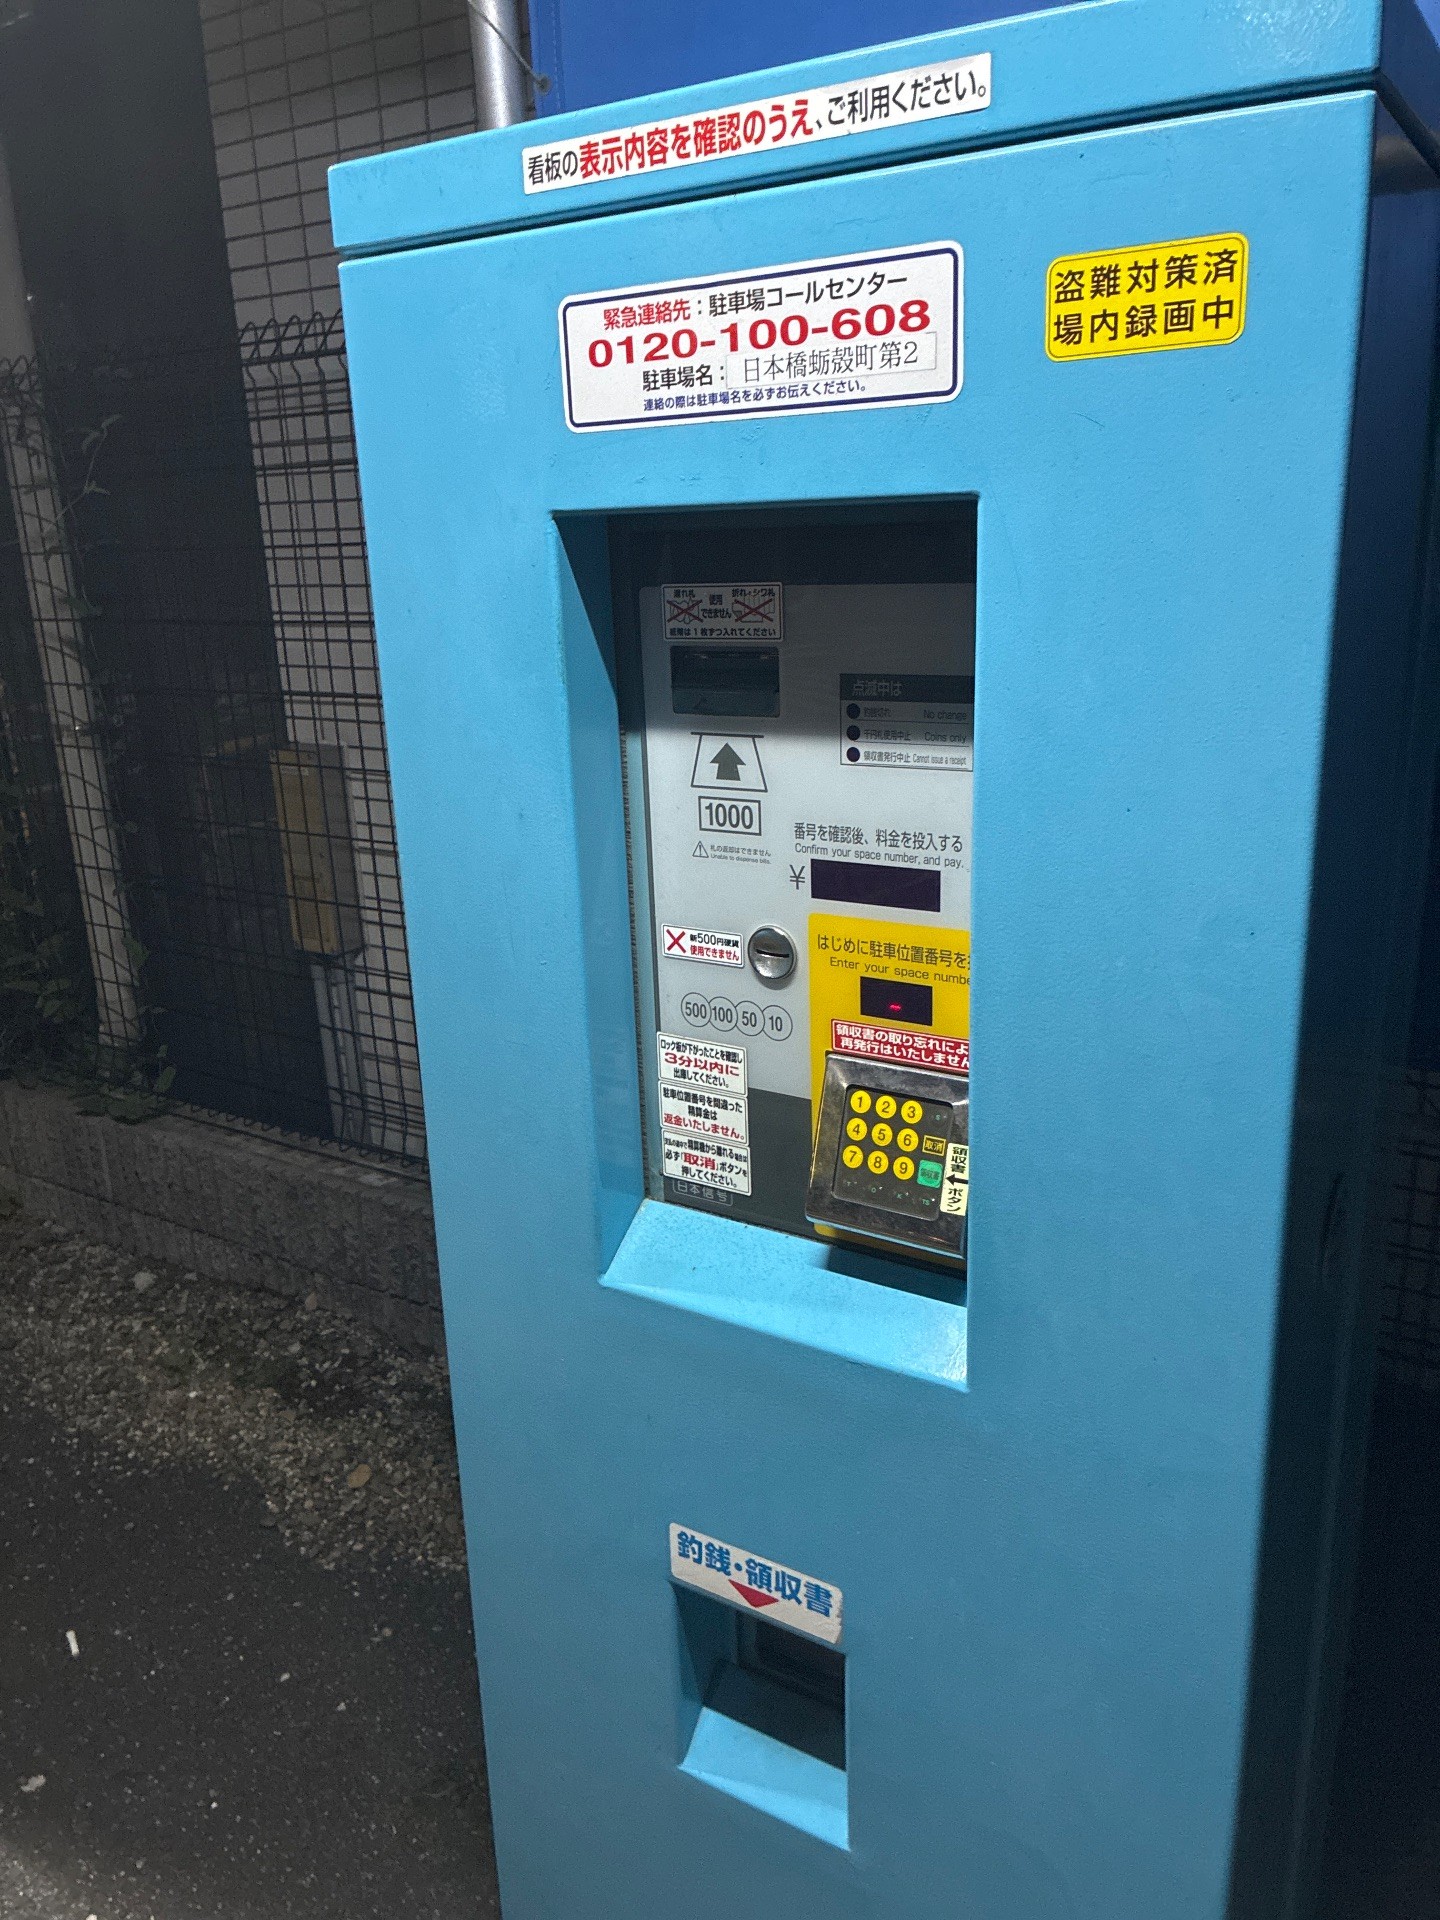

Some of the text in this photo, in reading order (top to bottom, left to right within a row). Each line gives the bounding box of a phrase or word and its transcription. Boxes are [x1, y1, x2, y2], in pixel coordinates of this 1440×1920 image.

[528, 71, 987, 185] 看板の表示内容を確認のうえ、ご利用ください。
[1054, 248, 1238, 303] 盗難対策済
[587, 299, 931, 368] 0120-100-608
[1053, 295, 1234, 346] 場内録画中
[644, 380, 867, 411] 連絡の際は駐車場名を必ずお伝えください。
[924, 732, 967, 744] Coins only
[704, 802, 754, 830] 1000
[794, 822, 963, 852] 番号を確認後、料金を投入する
[795, 843, 964, 870] Confirm your space number, and pay.
[690, 944, 740, 961] 使用できません
[817, 933, 970, 970] はじめに駐車位置番号を
[830, 957, 860, 970] Enter
[864, 962, 890, 974] your
[894, 967, 930, 980] space
[685, 1001, 783, 1032] 500 100 50 10
[857, 1096, 916, 1118] 1 2 3
[664, 1112, 745, 1140] 返金いたしません。
[852, 1123, 912, 1146] 4 5 6
[849, 1151, 908, 1175] 7 8 9
[946, 1188, 964, 1212] ボタン
[677, 1530, 833, 1618] 釣銭・領収書
